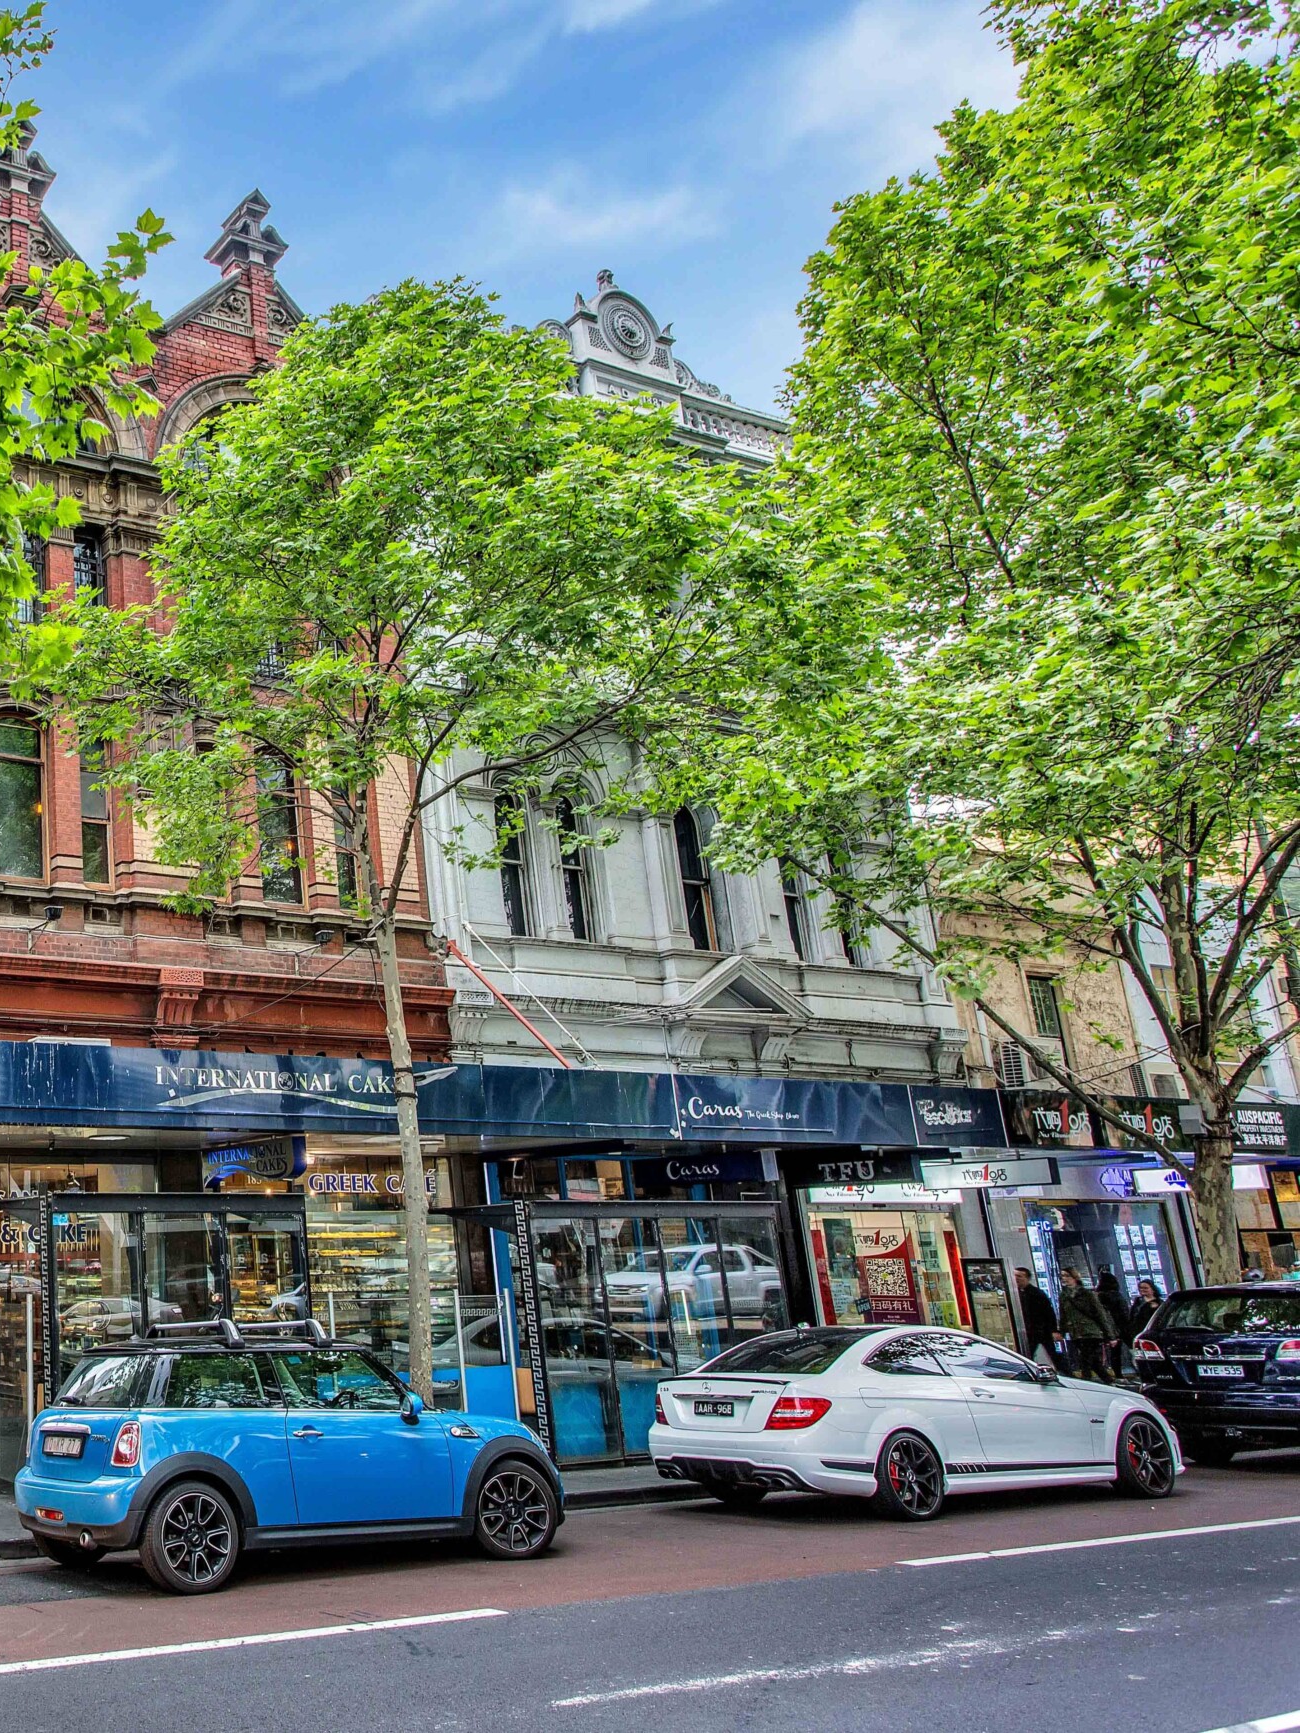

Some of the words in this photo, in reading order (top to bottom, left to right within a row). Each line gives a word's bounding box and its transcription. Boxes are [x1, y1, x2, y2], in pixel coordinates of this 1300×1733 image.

[155, 1065, 338, 1092] INTERNATIONAL
[688, 1096, 742, 1119] Caras
[1237, 1110, 1283, 1124] AUSPACIFIC
[308, 1173, 378, 1194] GREEK
[385, 1168, 436, 1194] CÉ
[666, 1160, 720, 1180] Caras
[818, 1159, 875, 1182] TFU
[1, 1223, 20, 1245] &
[27, 1223, 87, 1246] CKE
[872, 1300, 914, 1311] 扫码有礼
